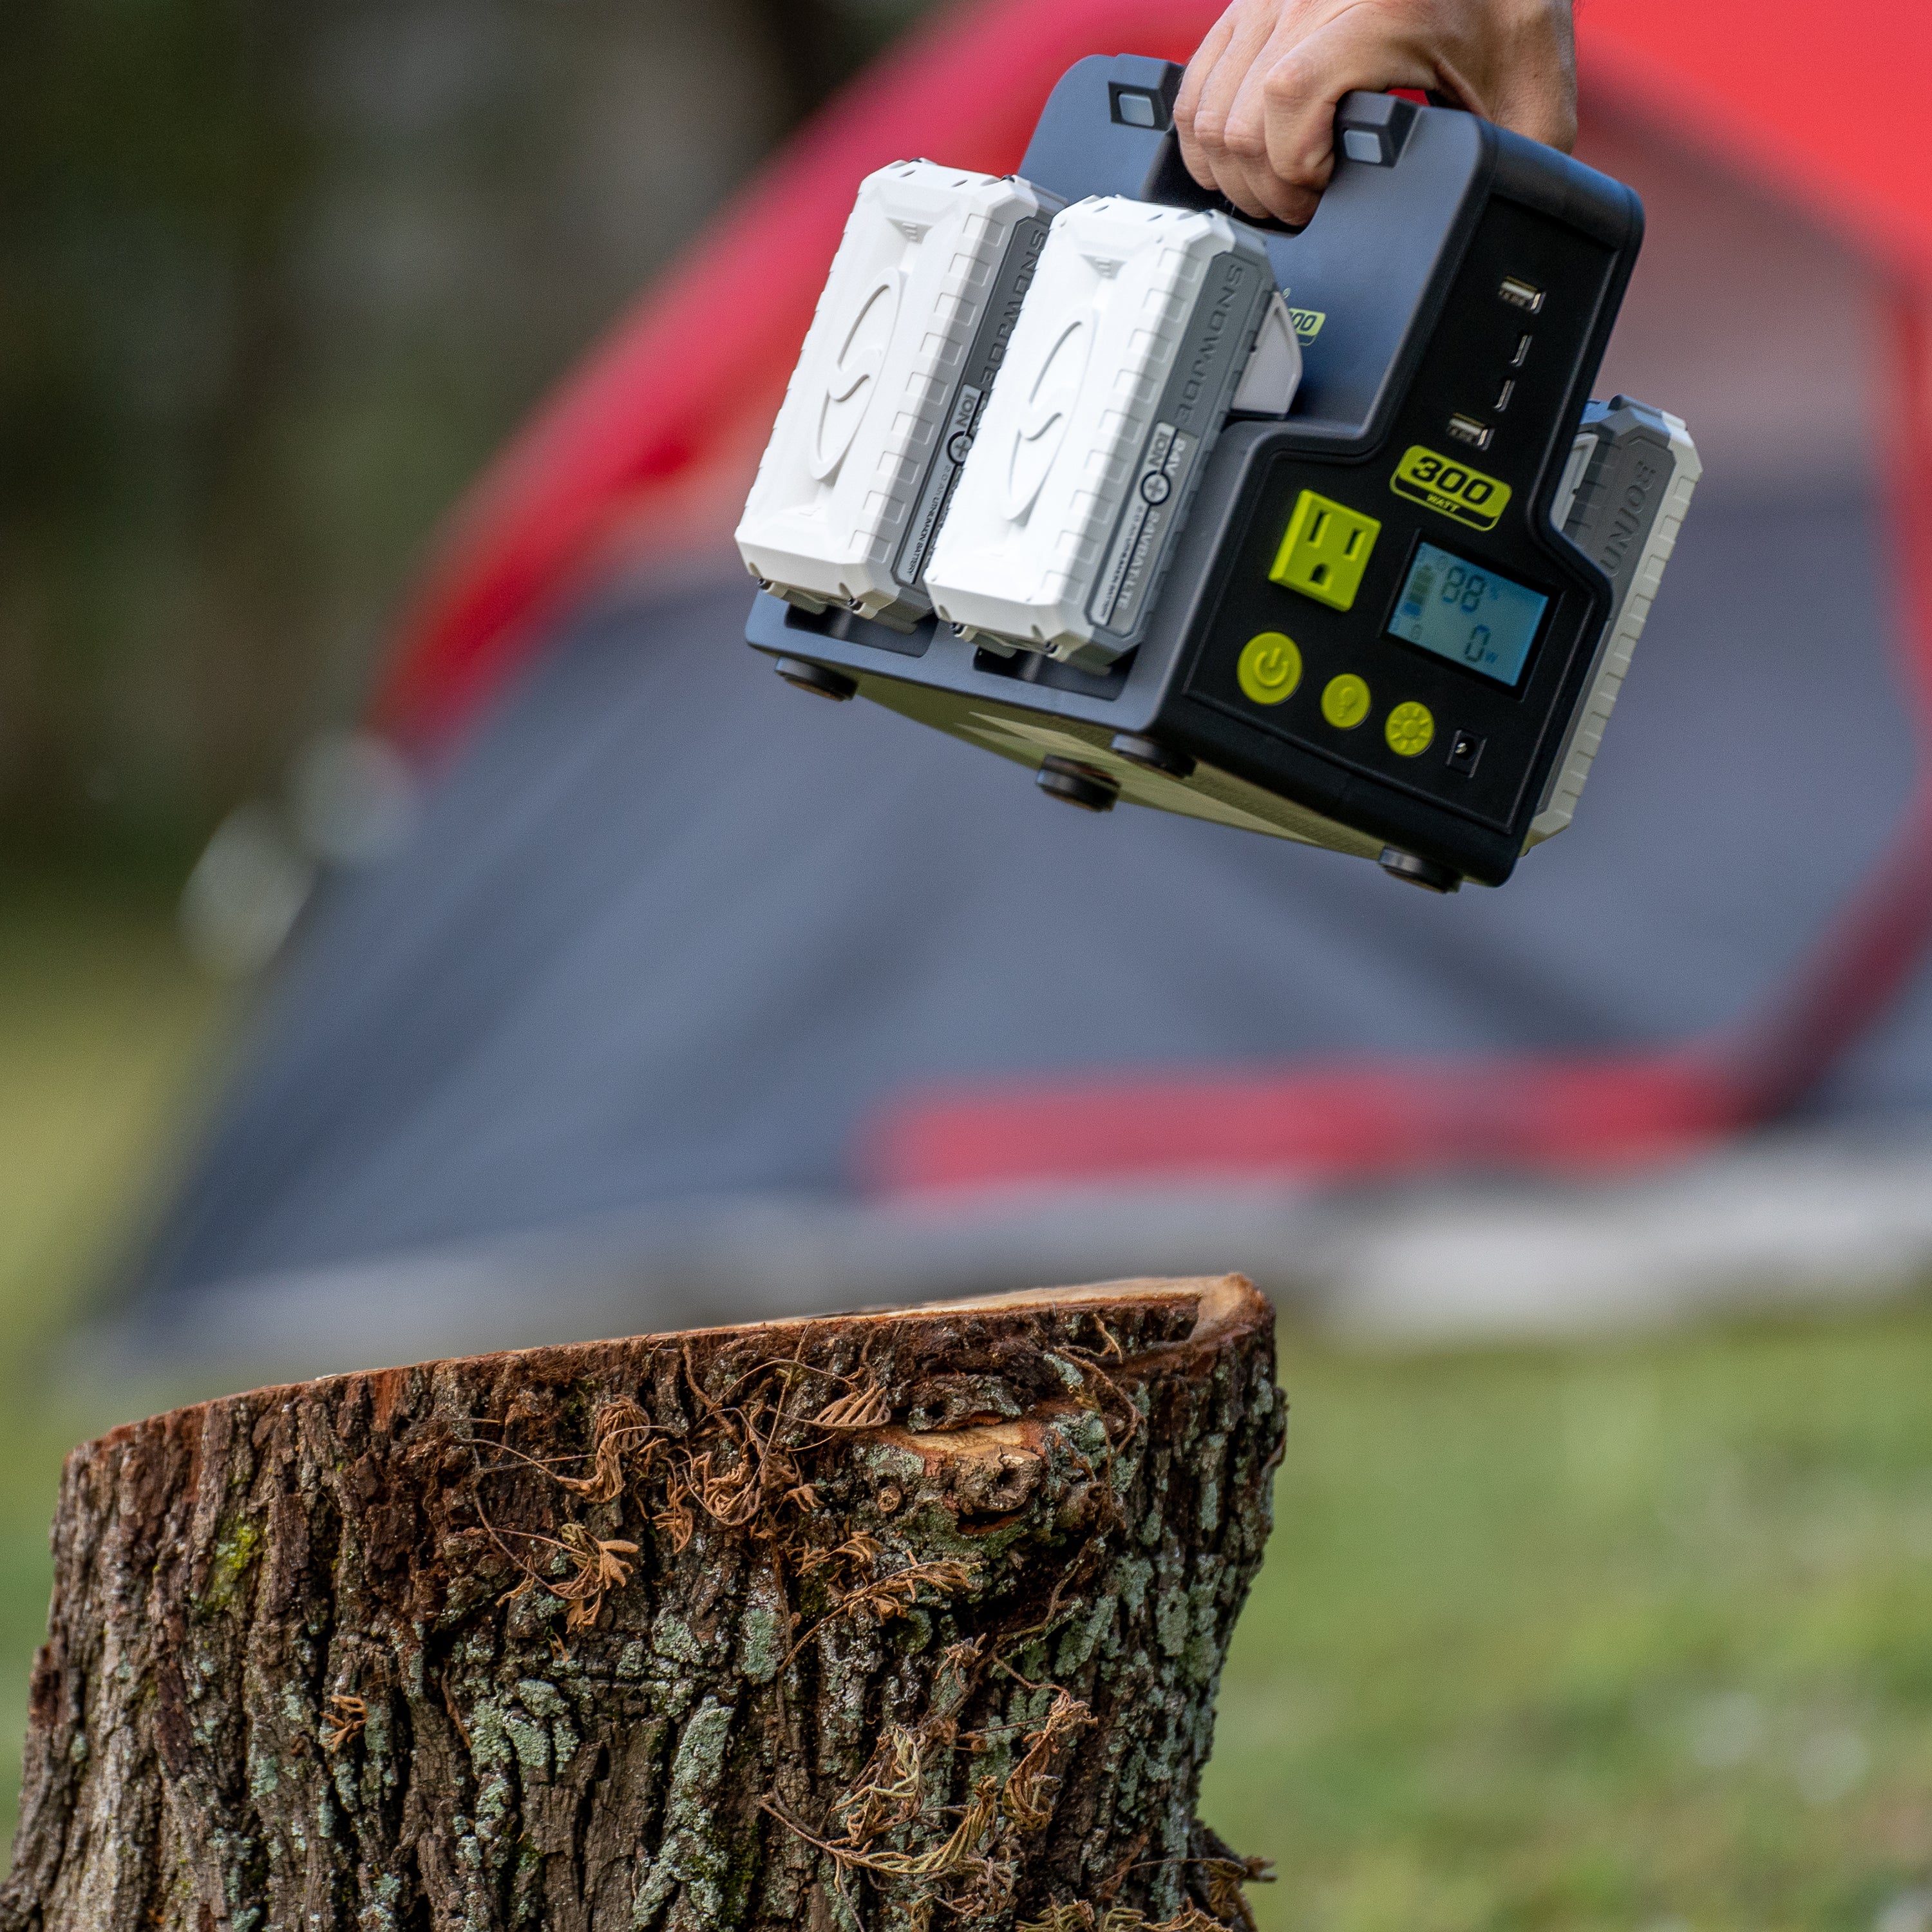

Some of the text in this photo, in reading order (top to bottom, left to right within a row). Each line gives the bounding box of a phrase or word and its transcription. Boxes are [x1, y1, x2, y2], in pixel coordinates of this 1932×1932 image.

[978, 228, 1048, 388] SNOWJOE
[1289, 311, 1317, 332] 00
[1171, 262, 1247, 426] SNOWJOE
[954, 393, 978, 428] ION
[1146, 430, 1170, 468] ION
[1162, 436, 1188, 478] 24V
[1411, 457, 1494, 505] 300
[1426, 493, 1461, 513] WATT
[905, 541, 923, 575] BATTERY
